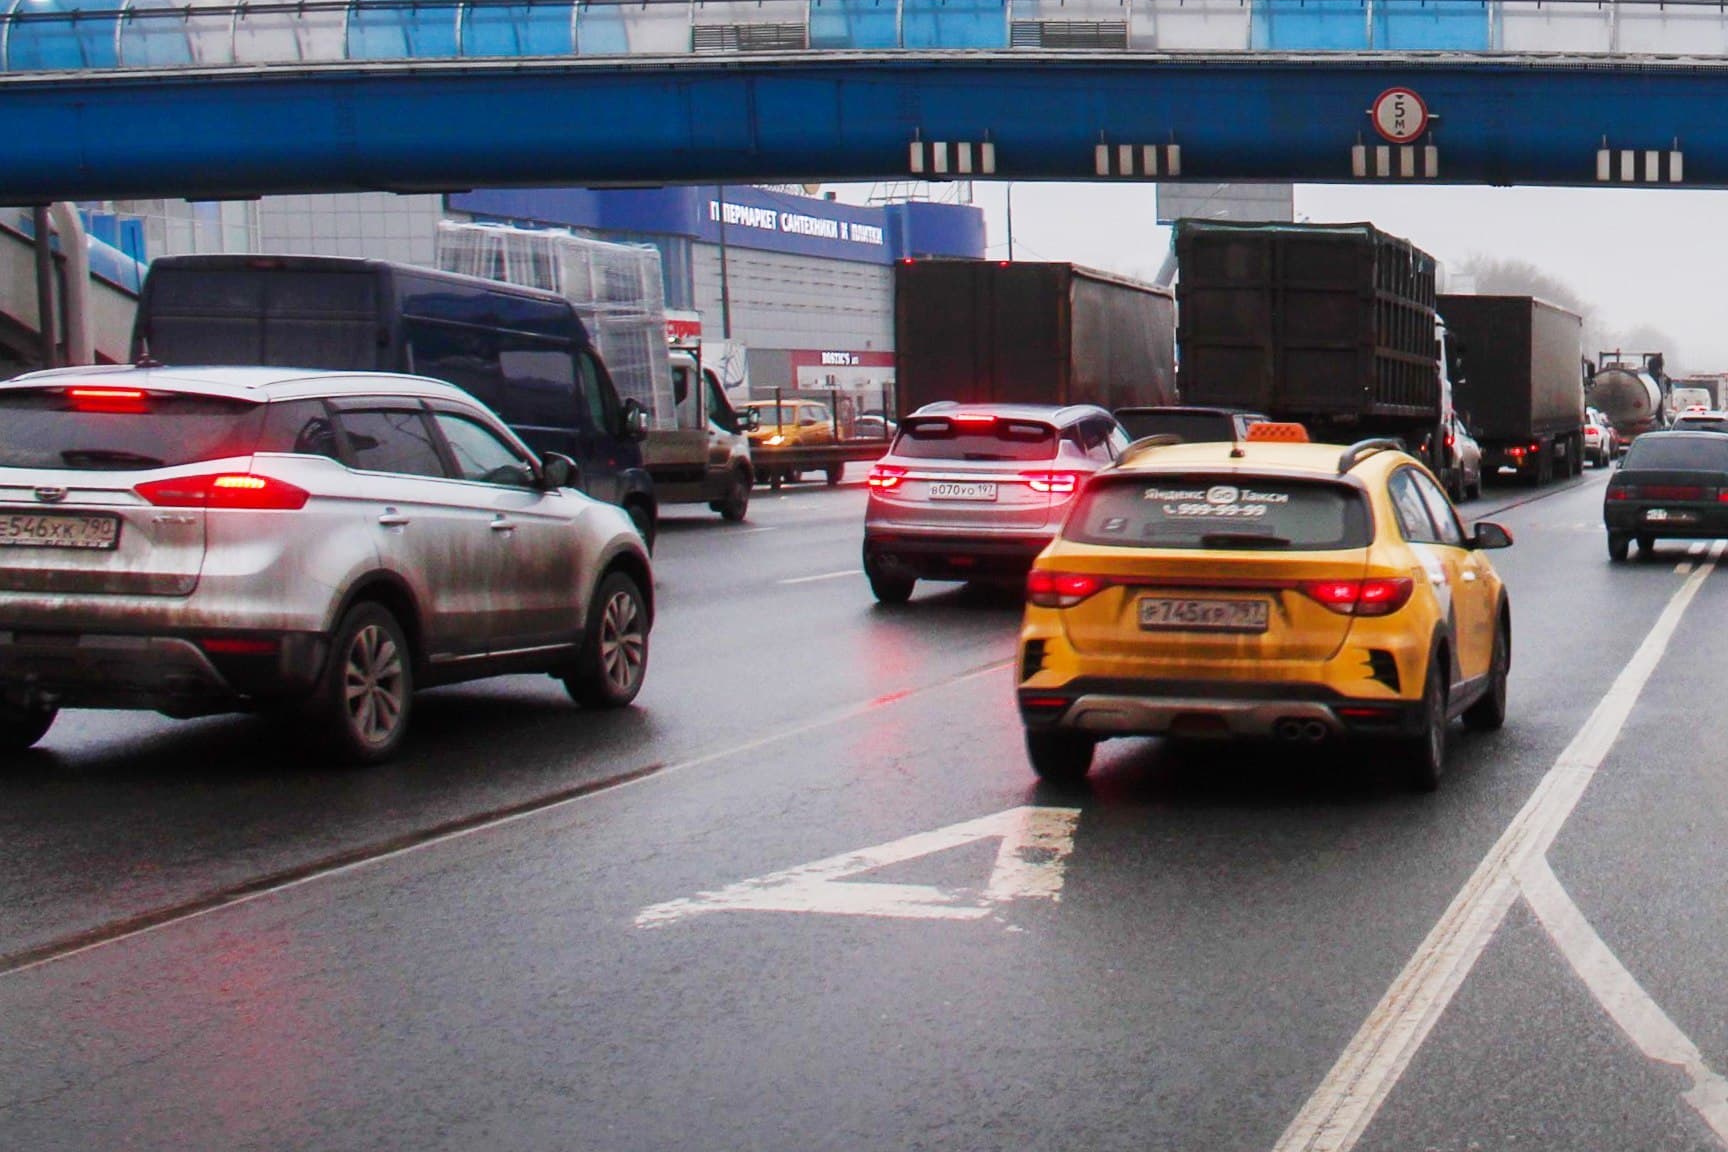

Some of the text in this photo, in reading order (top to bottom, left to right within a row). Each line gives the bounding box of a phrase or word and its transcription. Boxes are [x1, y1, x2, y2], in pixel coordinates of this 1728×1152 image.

[1394, 101, 1406, 118] 5
[780, 212, 838, 239] САНТЕХНИКИ
[1240, 489, 1289, 503] Такси
